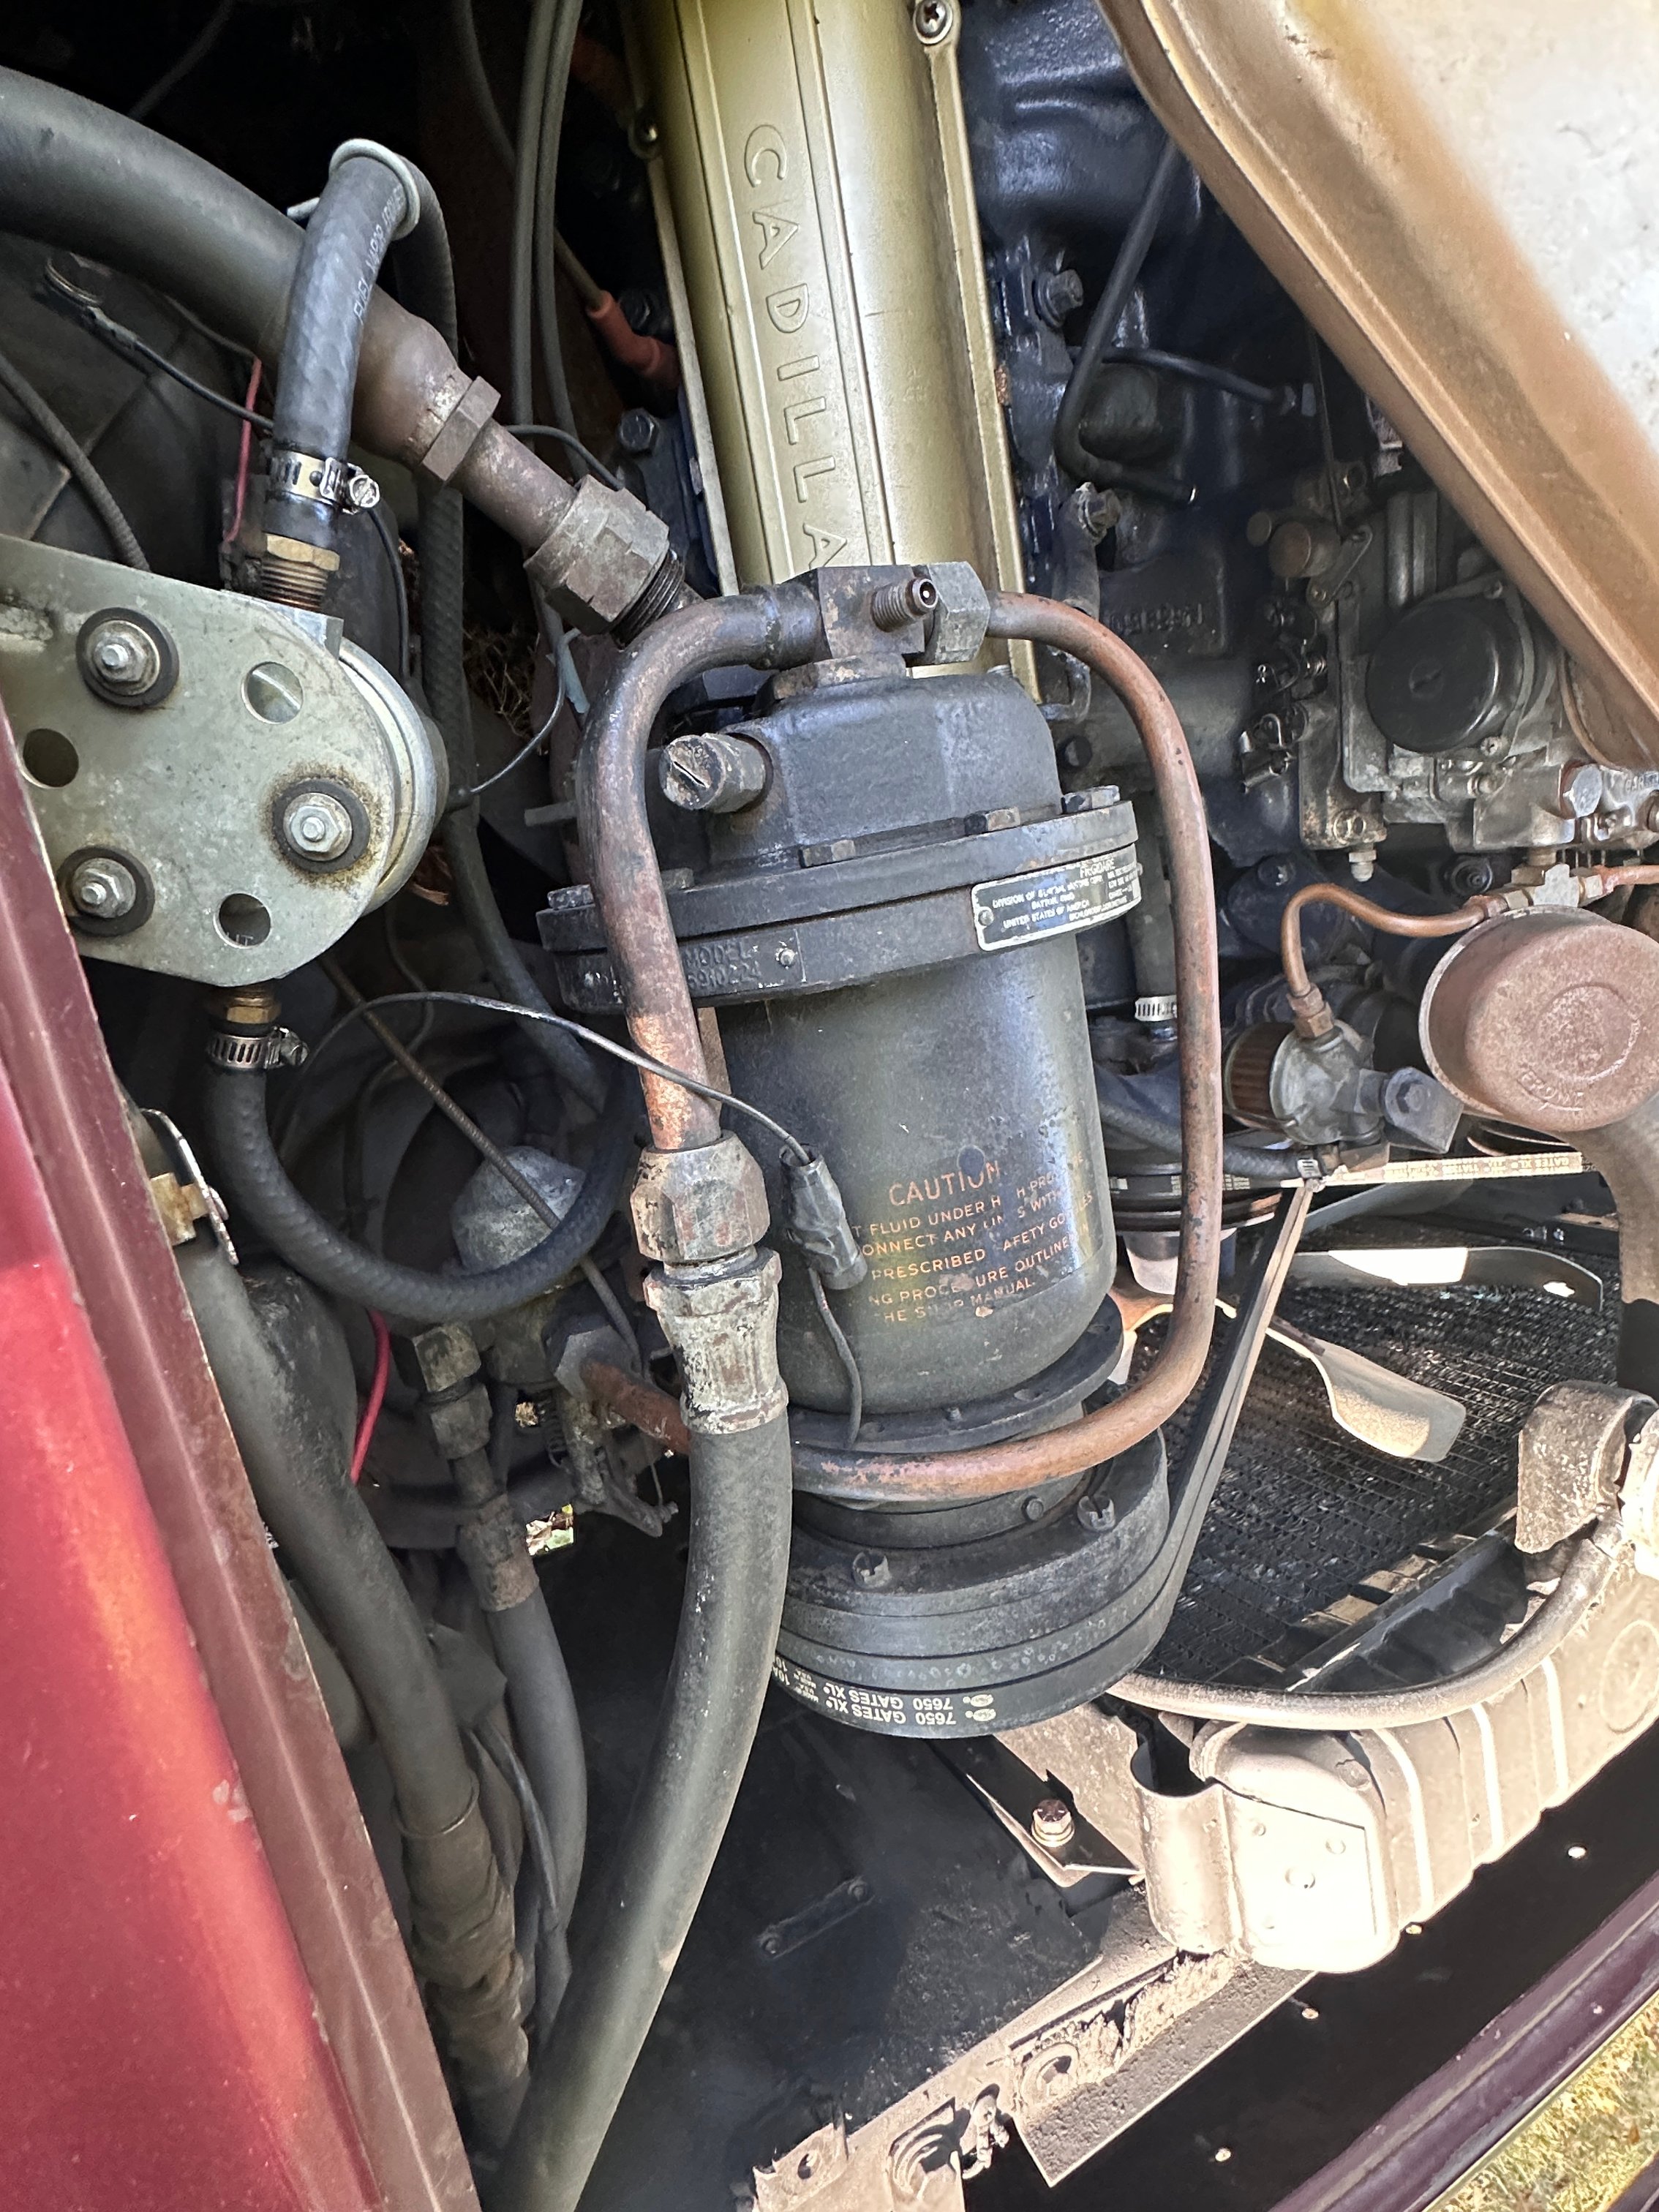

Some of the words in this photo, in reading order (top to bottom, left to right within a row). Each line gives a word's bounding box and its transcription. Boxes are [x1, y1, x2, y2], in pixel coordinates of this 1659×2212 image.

[743, 124, 848, 570] CADILLA
[870, 1216, 921, 1236] FLUID
[928, 1200, 985, 1226] UNDER
[862, 1233, 939, 1256] ONNECT
[943, 1222, 977, 1243] ANY
[871, 1248, 986, 1281] PRESCRIBED
[1002, 1222, 1045, 1252] AFETY
[848, 1688, 904, 1710] GATES
[912, 1697, 954, 1711] 7650
[851, 1703, 907, 1725] GATES
[914, 1711, 957, 1726] 7650
